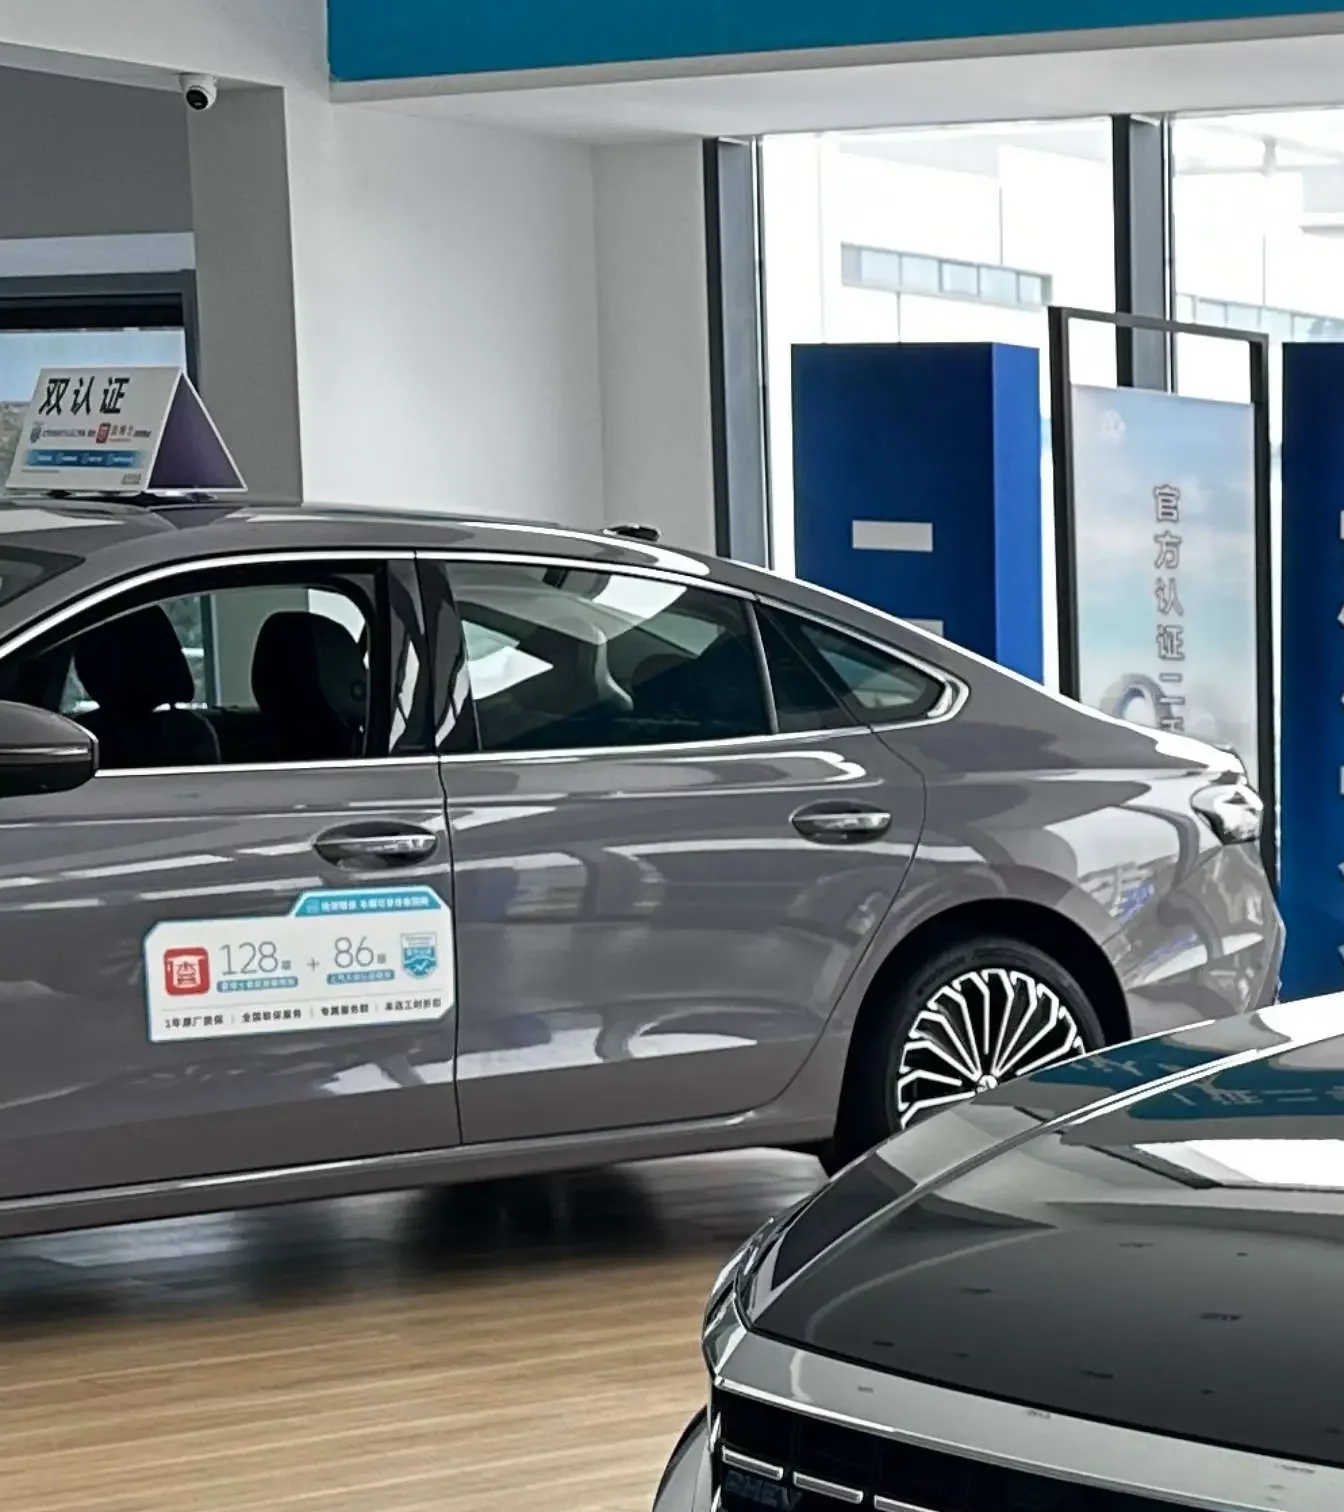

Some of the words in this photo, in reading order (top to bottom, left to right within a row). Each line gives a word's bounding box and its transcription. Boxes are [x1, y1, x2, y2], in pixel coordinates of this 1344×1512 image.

[38, 376, 131, 416] 双认证
[219, 941, 279, 976] 128
[334, 936, 374, 969] 86
